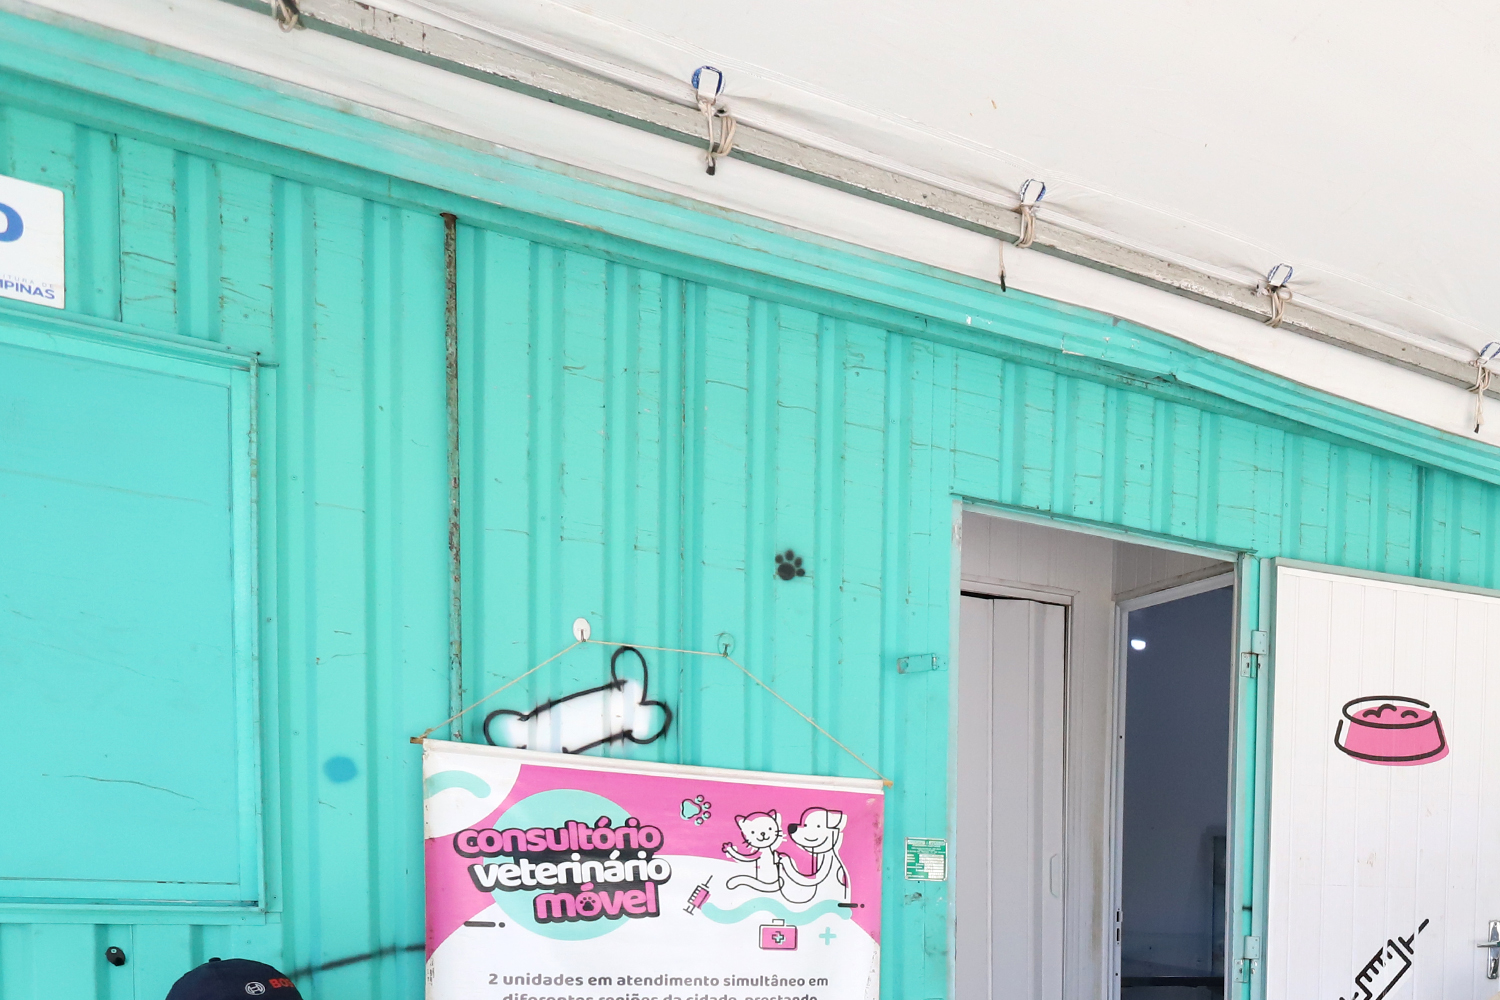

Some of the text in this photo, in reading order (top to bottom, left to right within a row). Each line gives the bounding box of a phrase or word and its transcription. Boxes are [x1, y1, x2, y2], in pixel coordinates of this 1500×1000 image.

[455, 817, 663, 855] consultório
[471, 851, 671, 890] veterinário
[534, 883, 659, 920] móvel
[489, 973, 828, 986] 2 unidades em atendimento simultâneo em
